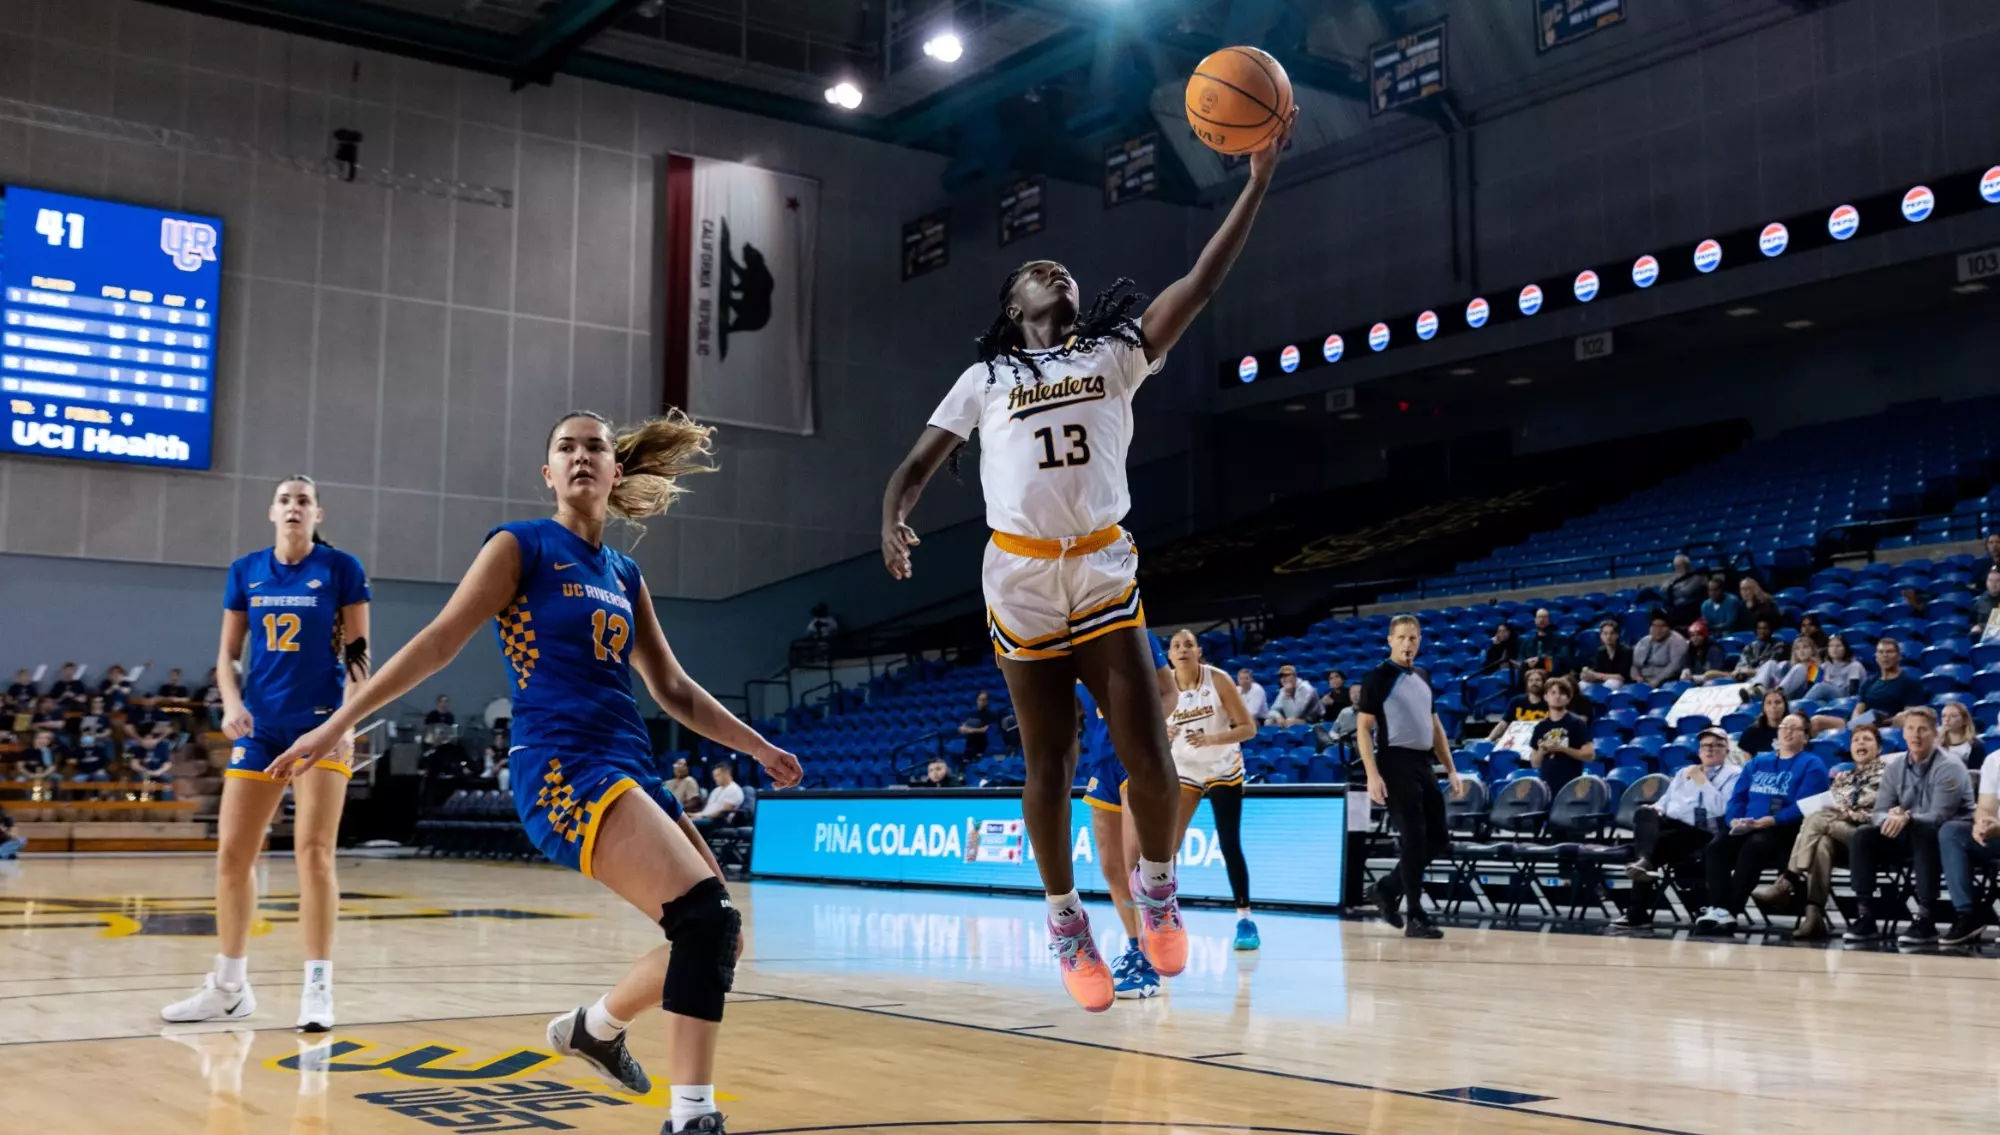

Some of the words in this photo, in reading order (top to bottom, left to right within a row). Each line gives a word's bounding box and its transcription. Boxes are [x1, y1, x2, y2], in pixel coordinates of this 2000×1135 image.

[35, 208, 85, 249] 41
[160, 218, 217, 272] UCR
[700, 219, 715, 288] CALIFORNIA
[1967, 252, 1999, 277] 103
[697, 298, 712, 356] REPUBLIC
[1582, 336, 1604, 356] 102
[1007, 375, 1106, 411] Anteaters
[12, 420, 75, 450] UCI
[83, 427, 190, 460] Health
[1034, 423, 1091, 470] 13
[562, 583, 584, 597] UC
[262, 613, 301, 651] 12
[814, 815, 863, 854] PIÑA
[866, 823, 962, 858] COLADA
